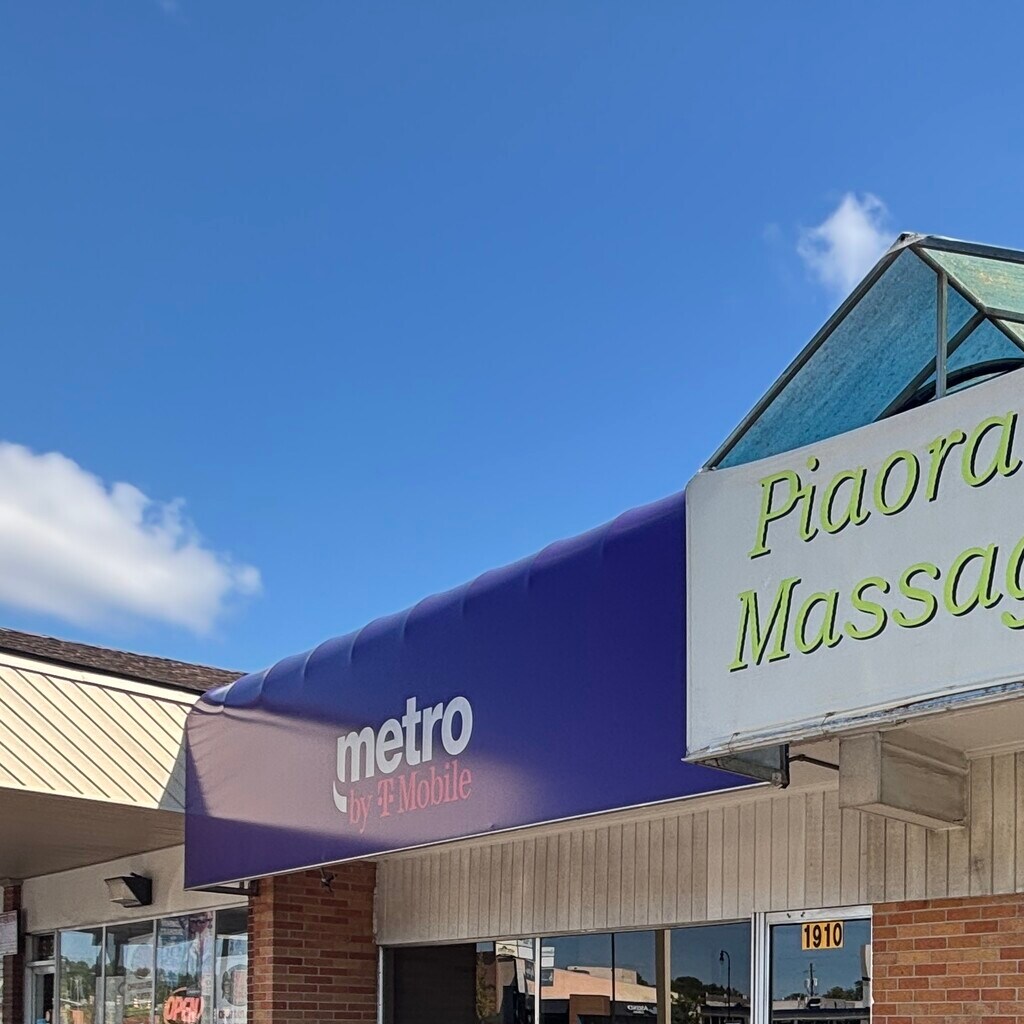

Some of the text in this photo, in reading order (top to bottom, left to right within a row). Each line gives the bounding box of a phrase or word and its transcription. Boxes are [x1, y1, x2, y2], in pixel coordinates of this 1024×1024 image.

[336, 696, 473, 783] metro
[350, 789, 373, 834] by
[804, 923, 842, 948] 1910
